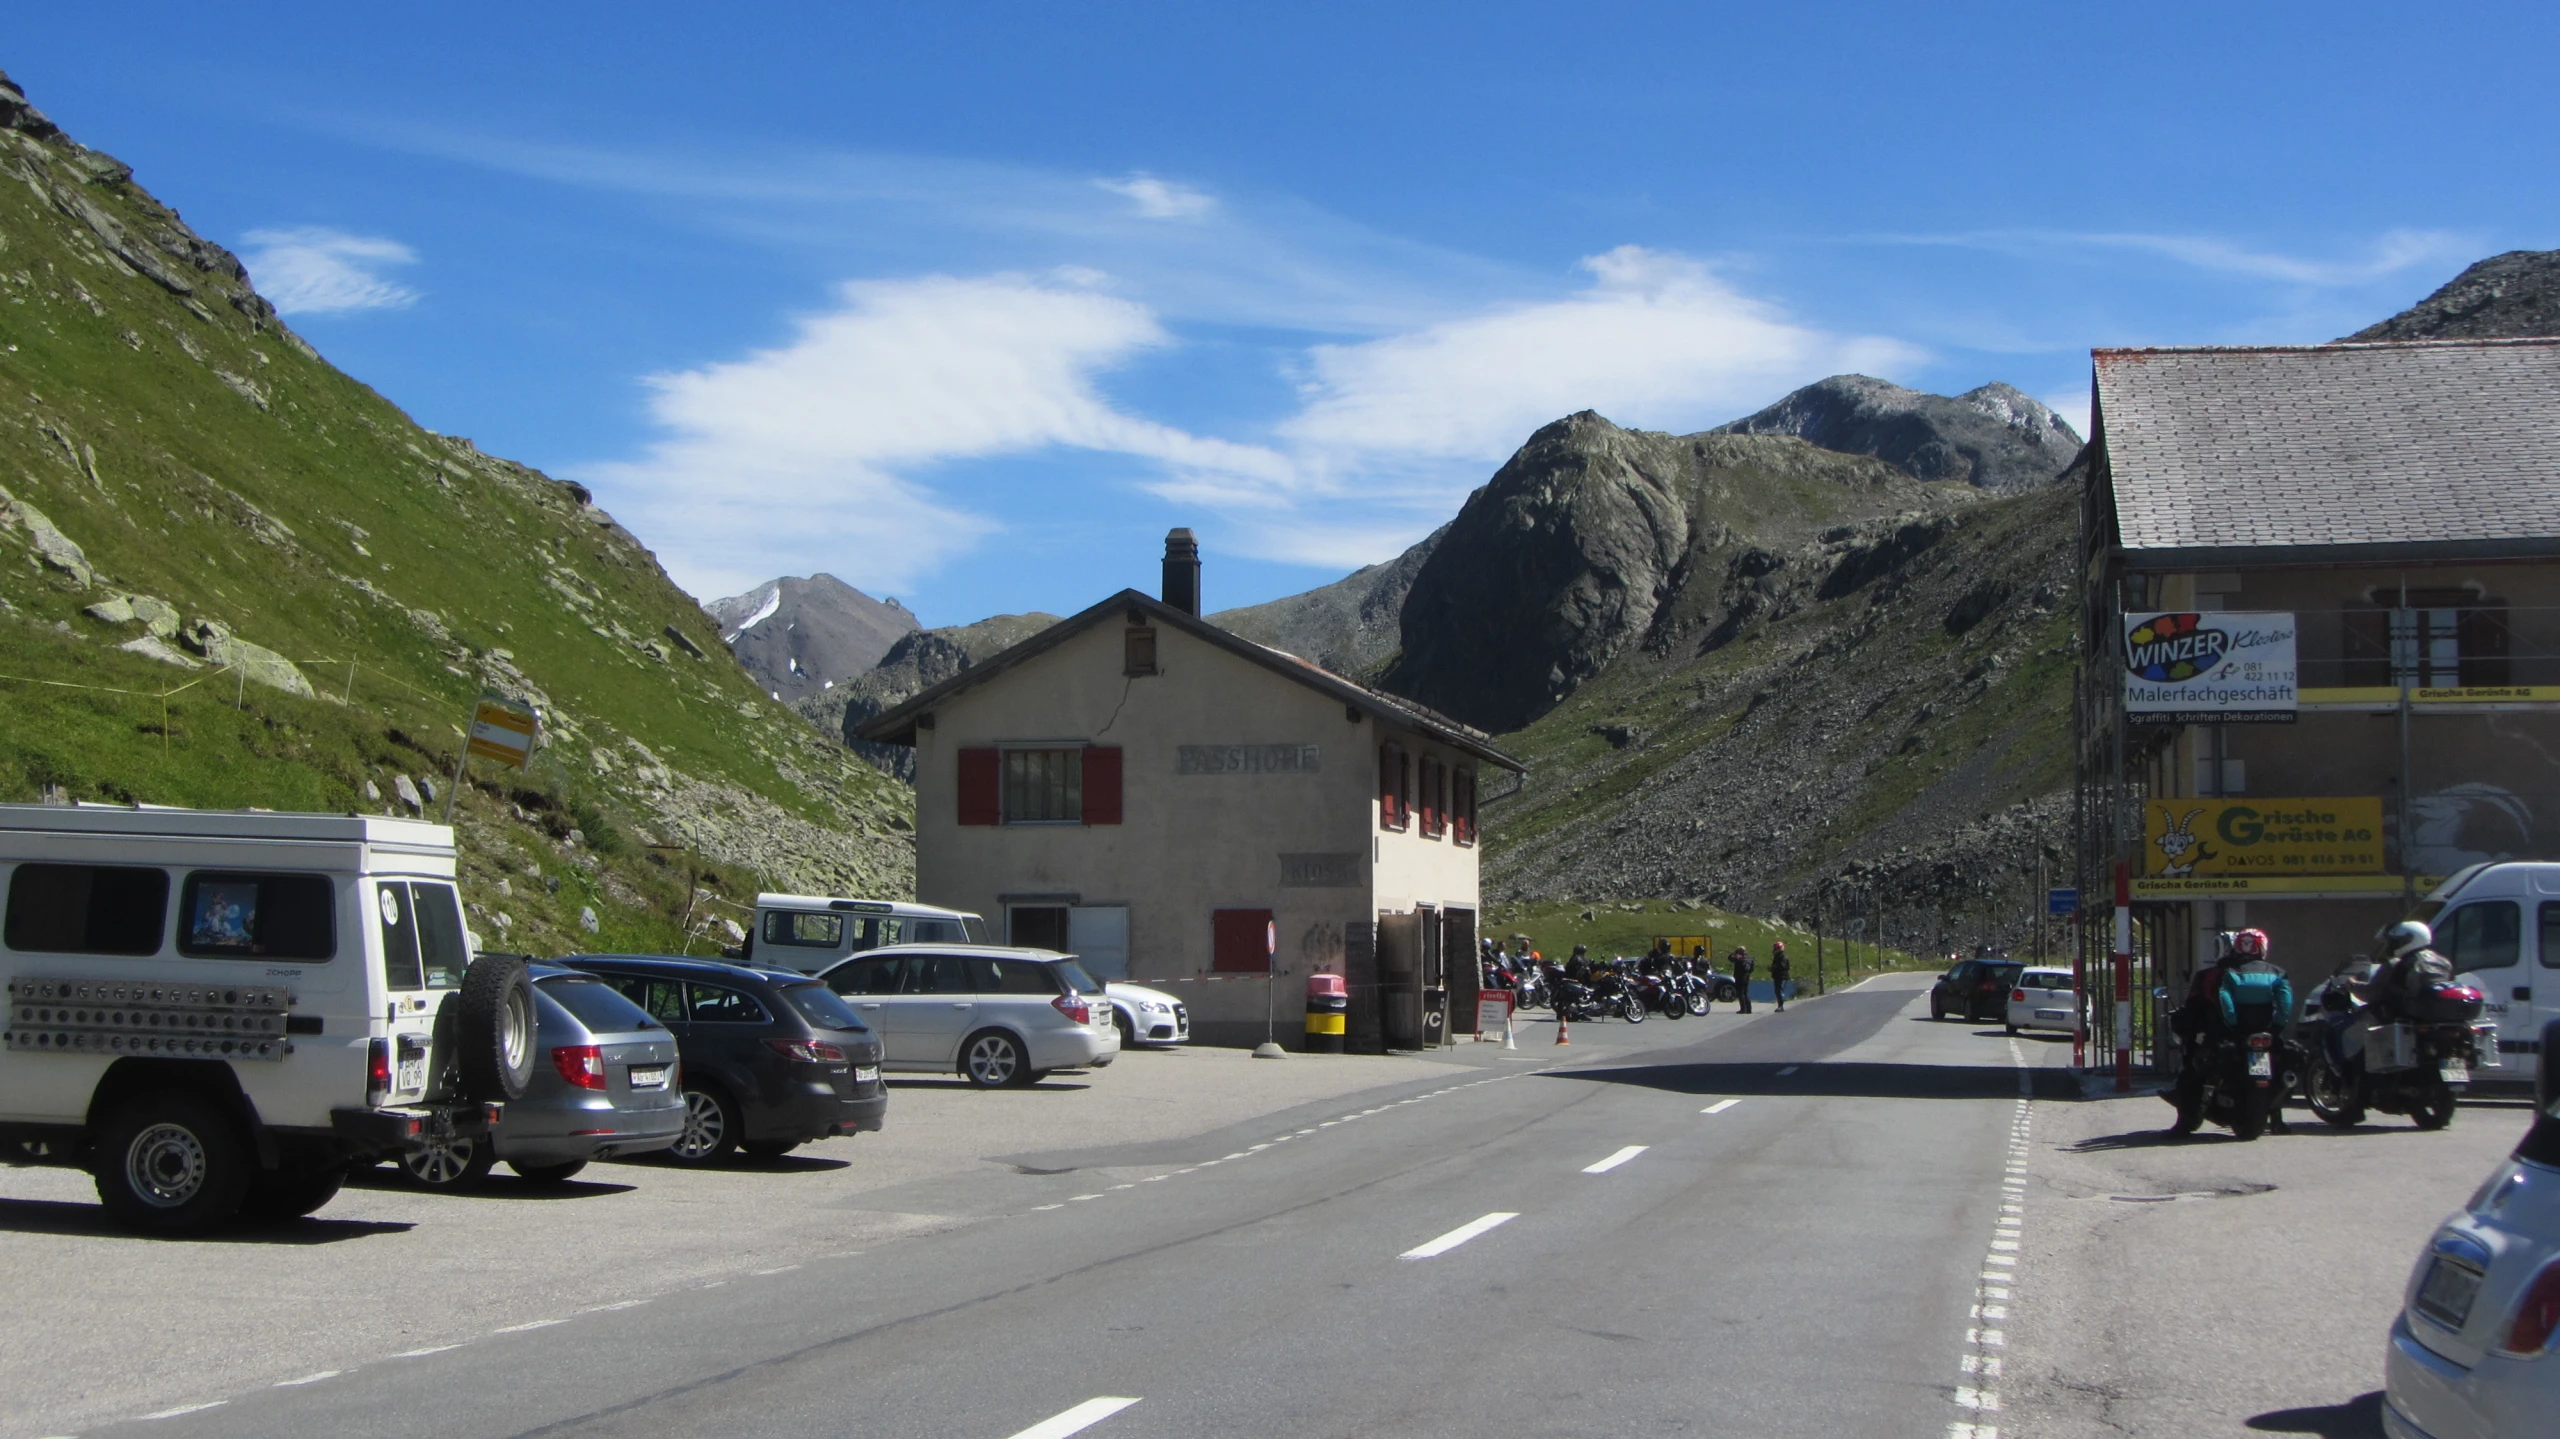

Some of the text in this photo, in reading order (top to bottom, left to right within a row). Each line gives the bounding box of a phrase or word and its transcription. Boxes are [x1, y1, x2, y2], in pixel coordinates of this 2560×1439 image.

[2126, 632, 2227, 669] WINZER
[2244, 662, 2262, 671] 081
[2244, 672, 2295, 681] 422 11 12
[2128, 686, 2293, 705] Malerfachgeschäft
[2420, 688, 2531, 698] Grischa Gerüste AG
[2129, 712, 2293, 725] Sgraffiti Schriften Dekorationen
[2343, 829, 2372, 842] AG
[2227, 854, 2275, 866] DAVOS
[2137, 880, 2248, 890] Grischa Gerüste AG
[382, 895, 397, 918] 110
